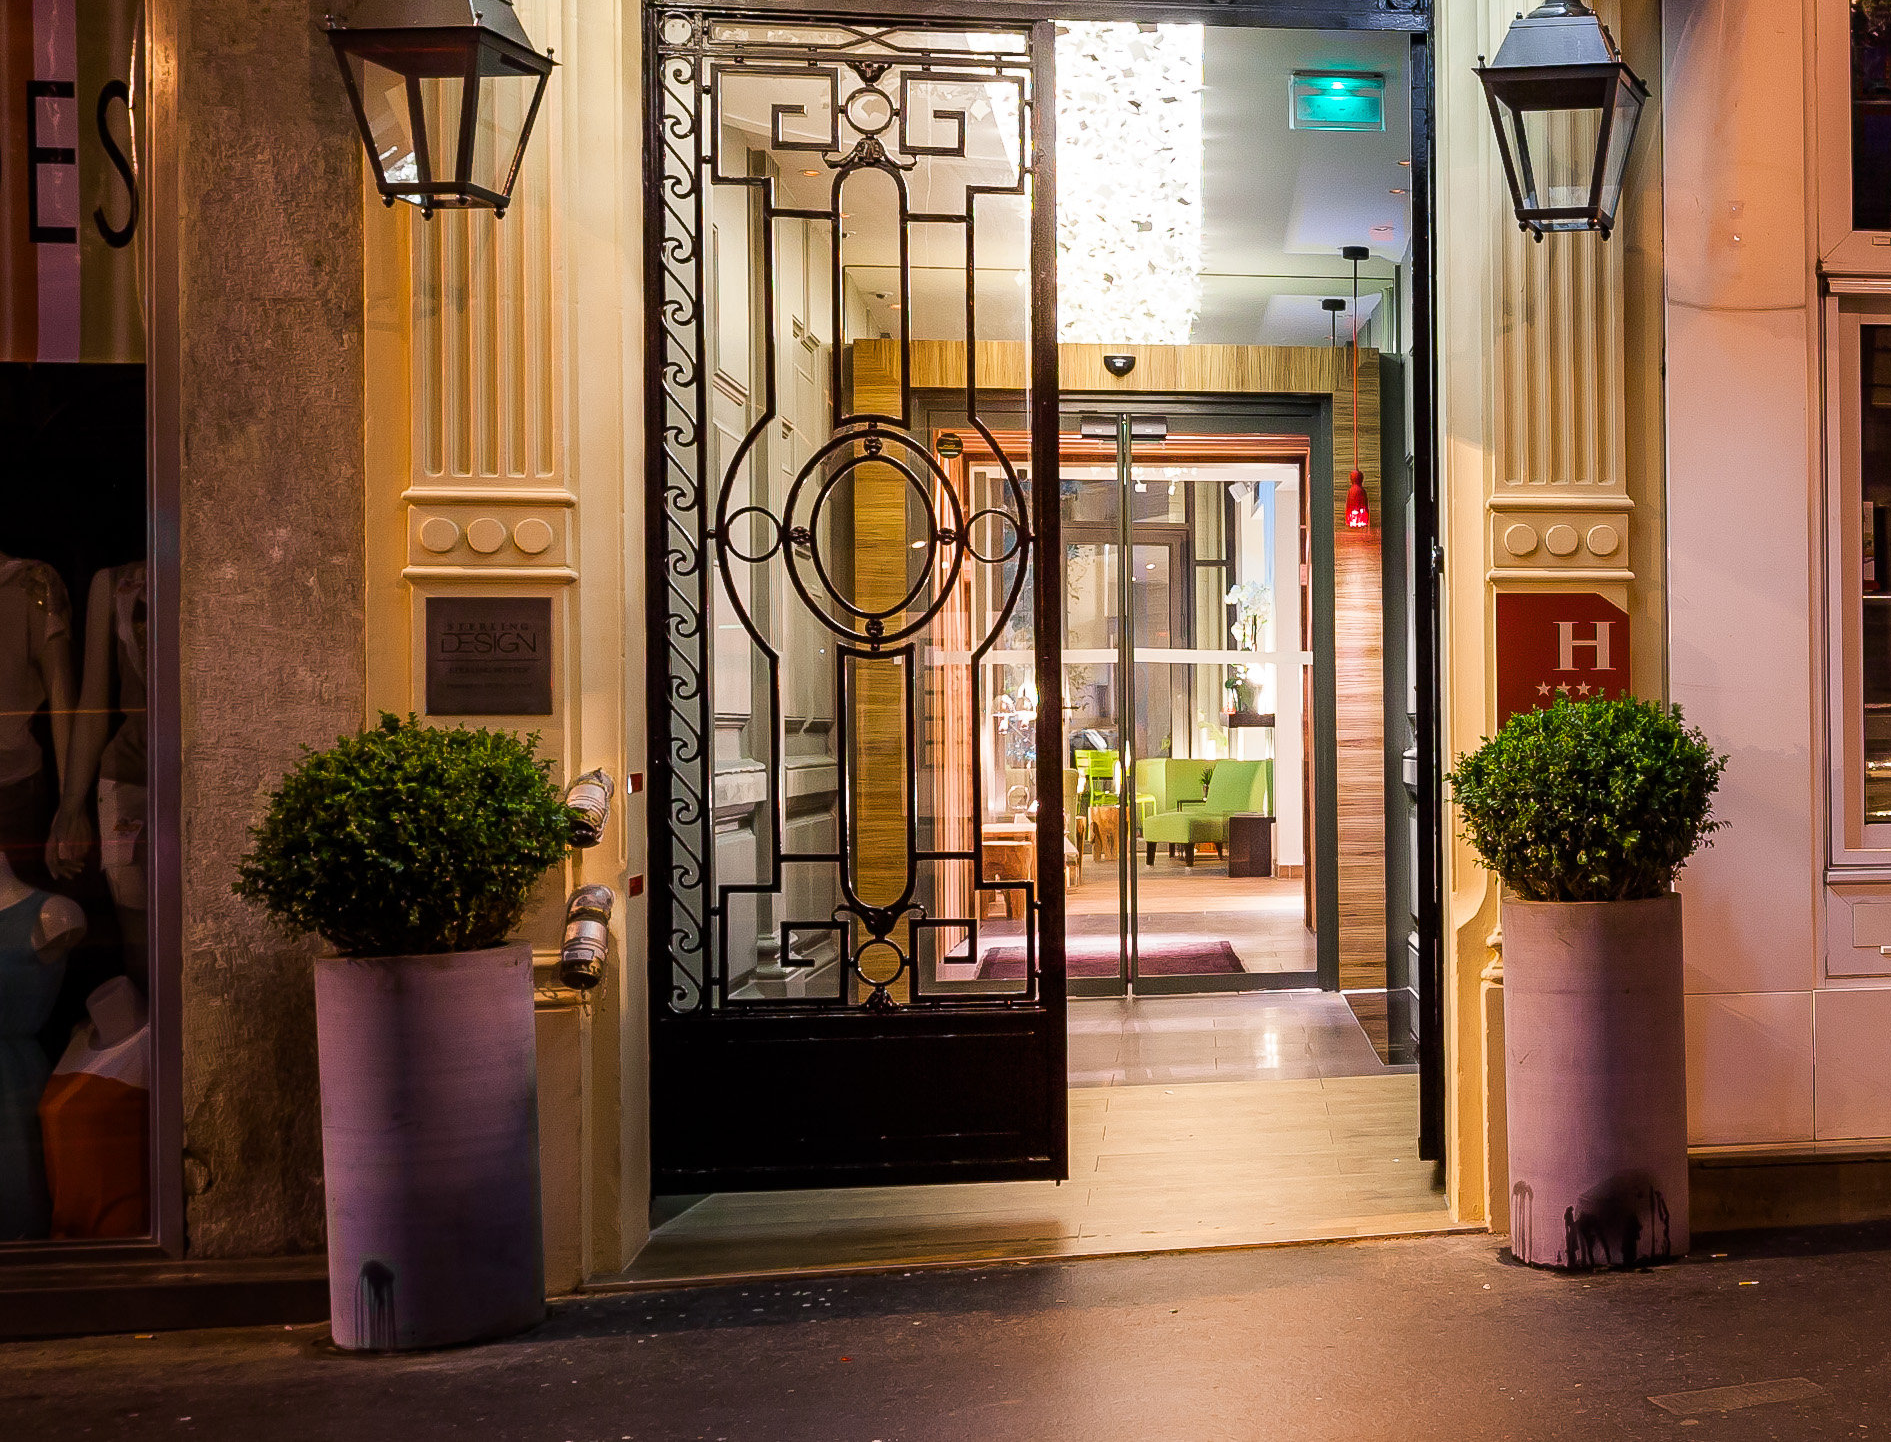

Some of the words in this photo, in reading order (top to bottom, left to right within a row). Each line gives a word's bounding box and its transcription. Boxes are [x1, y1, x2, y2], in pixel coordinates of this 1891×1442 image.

[0, 80, 139, 248] ES
[441, 632, 536, 654] DESIGN
[1552, 621, 1617, 671] H
